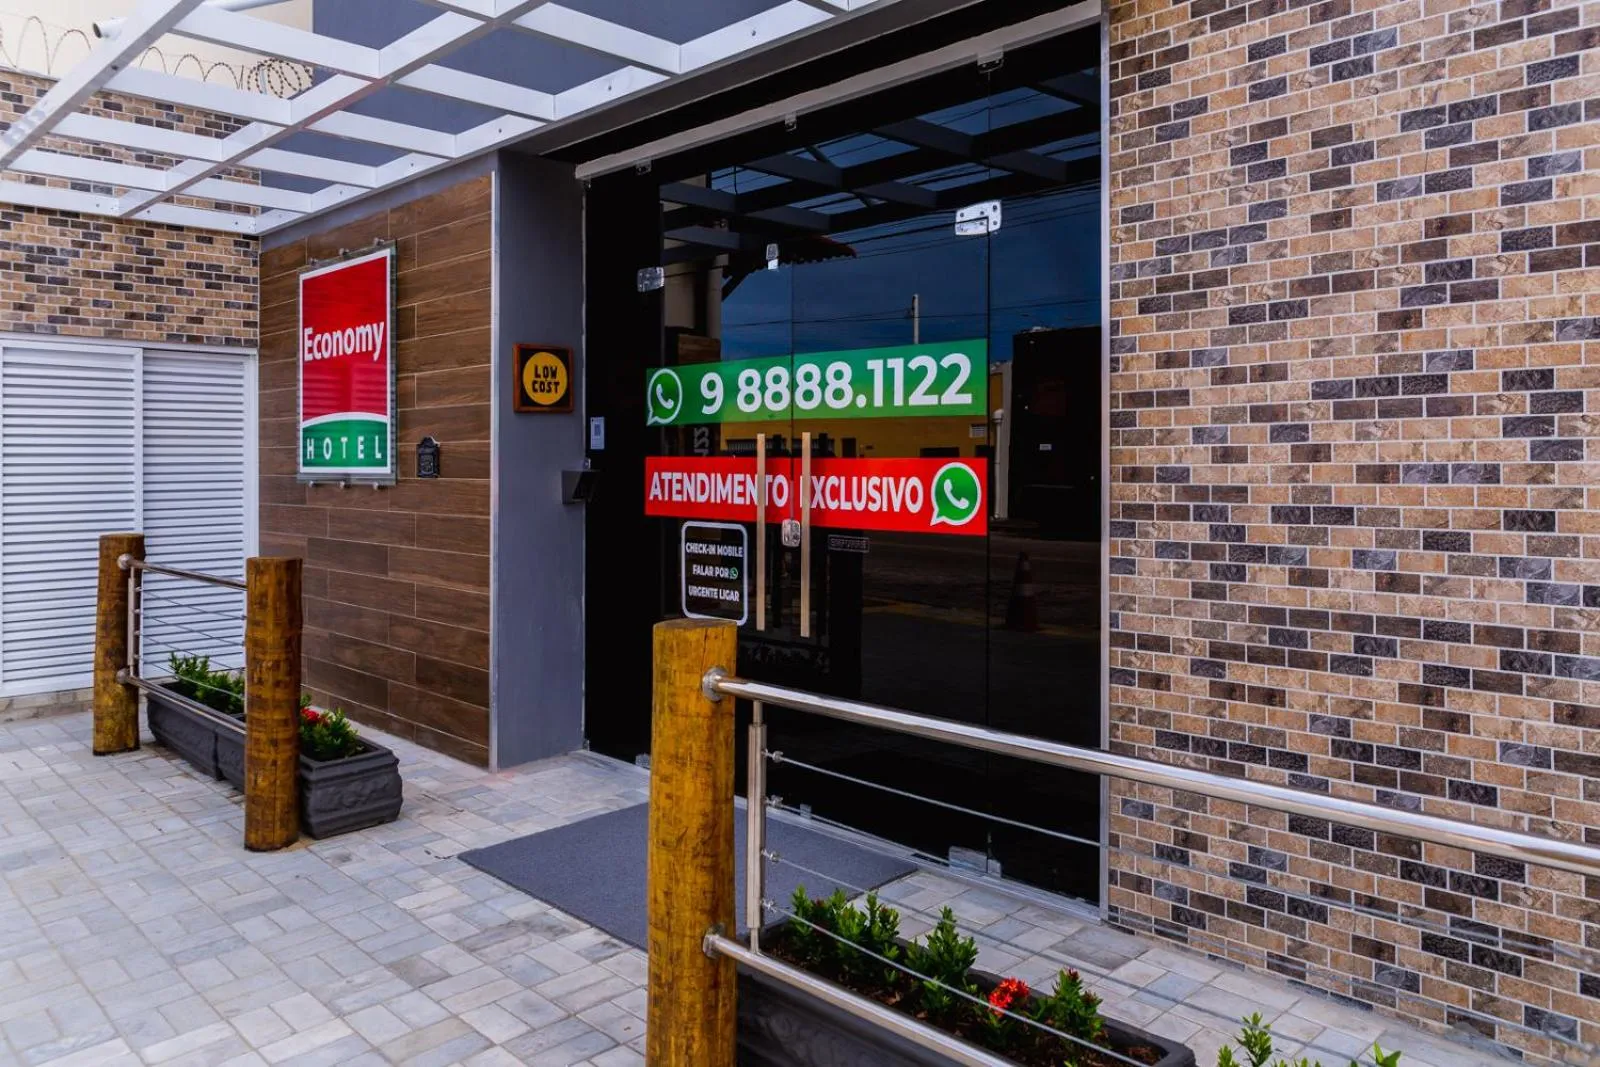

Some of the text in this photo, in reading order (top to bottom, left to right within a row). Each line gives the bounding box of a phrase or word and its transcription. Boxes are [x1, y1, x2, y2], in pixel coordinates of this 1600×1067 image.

[304, 321, 385, 362] Economy
[534, 364, 558, 380] LOW
[532, 380, 560, 394] COST
[700, 353, 973, 415] 9 8888.1122
[306, 435, 382, 460] HOTEL
[799, 474, 924, 513] XCLUSIVO
[685, 542, 744, 558] CHECK-IN MOBILE
[692, 564, 730, 579] FALAR POR
[688, 585, 740, 602] URGENTE LIGAR
